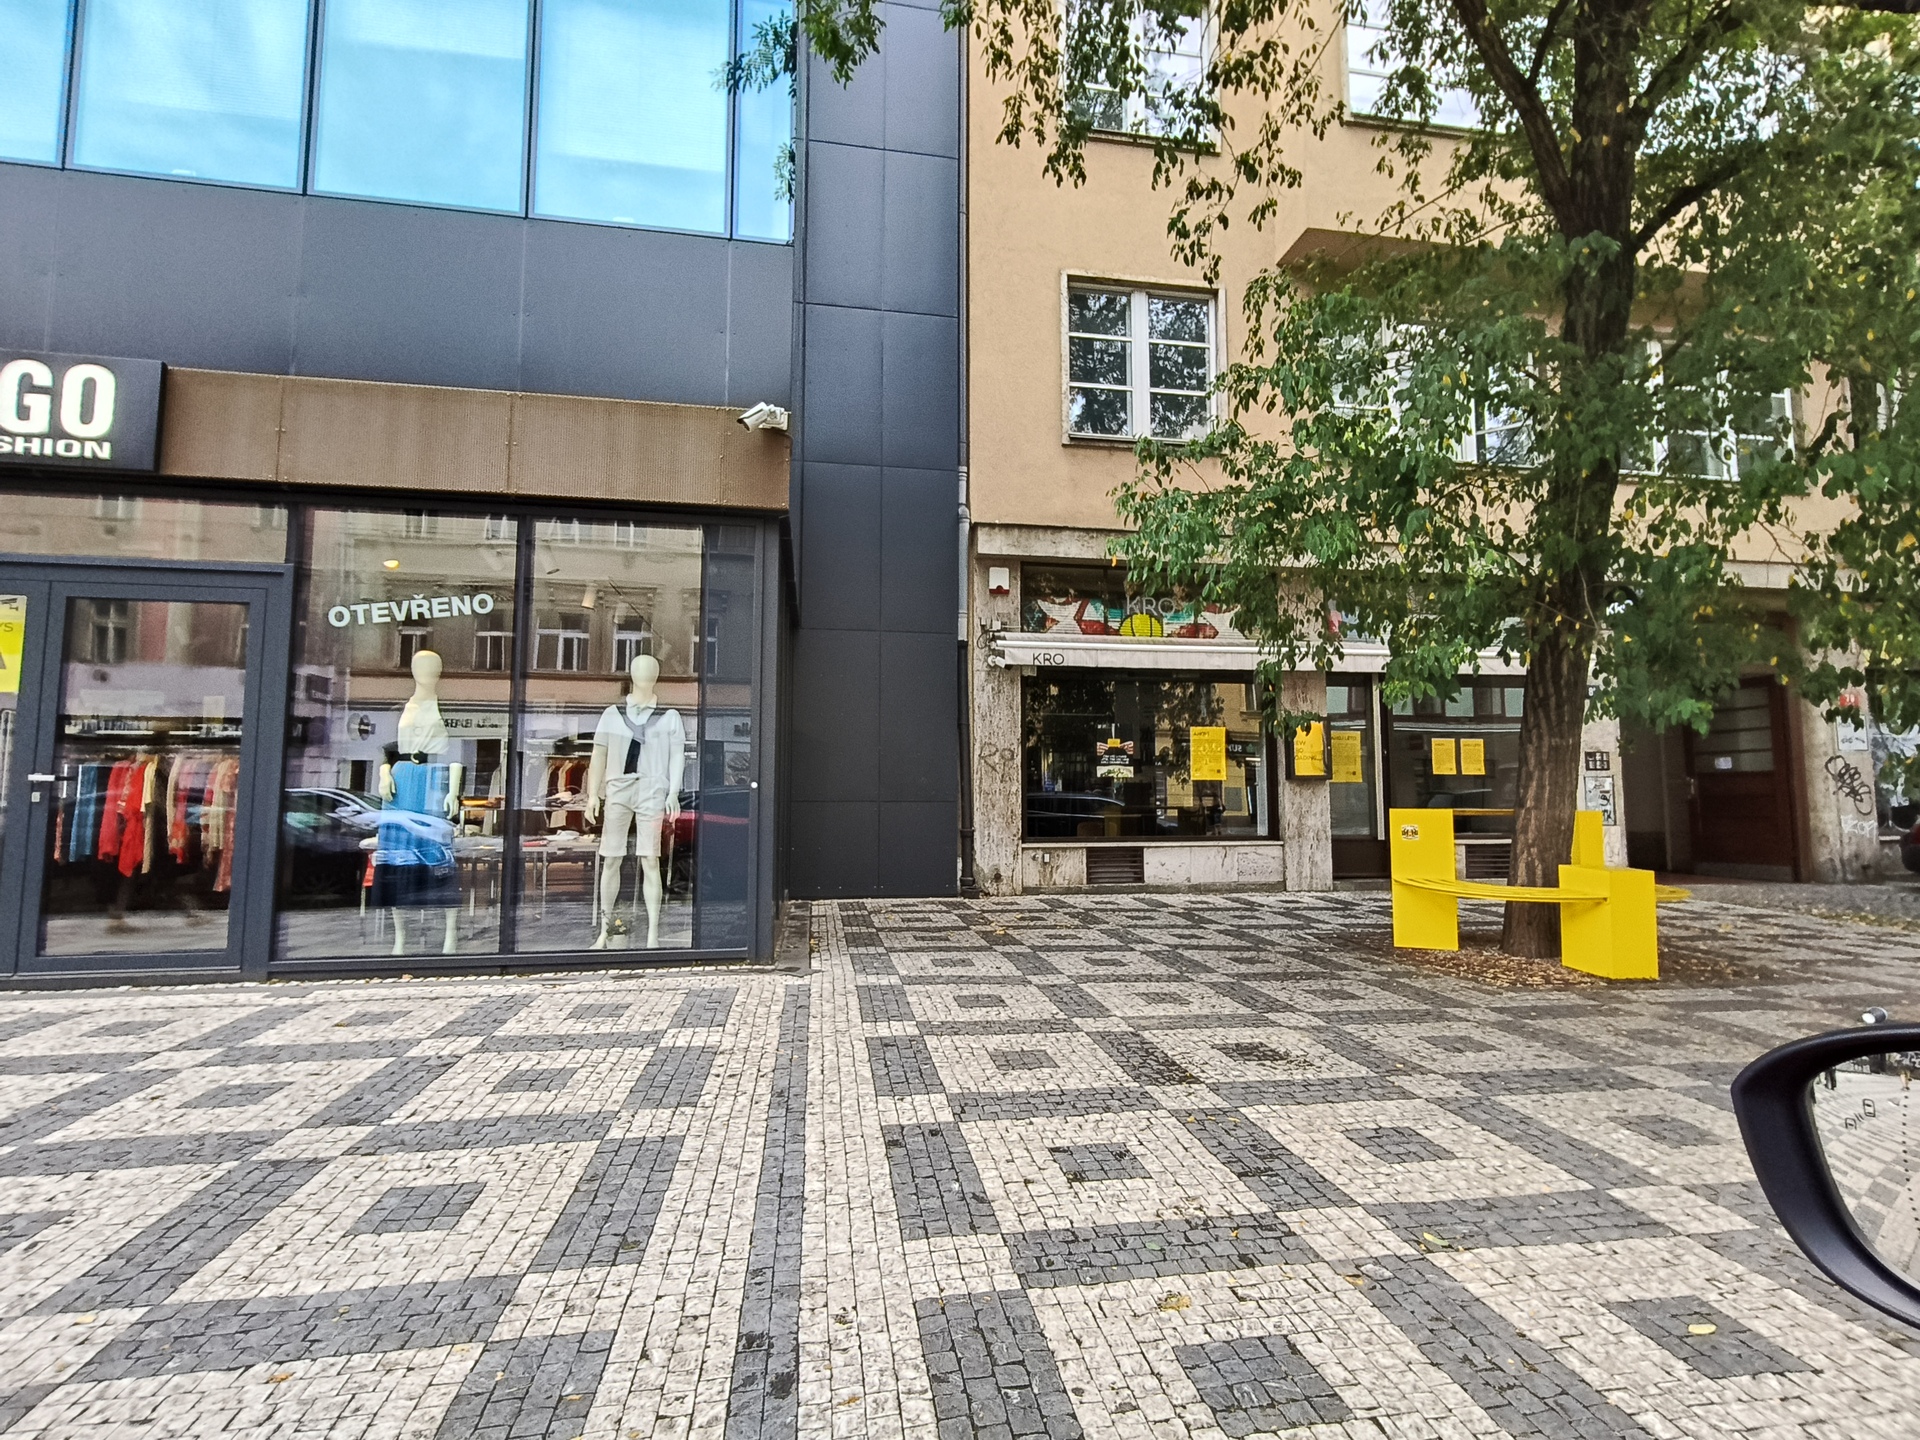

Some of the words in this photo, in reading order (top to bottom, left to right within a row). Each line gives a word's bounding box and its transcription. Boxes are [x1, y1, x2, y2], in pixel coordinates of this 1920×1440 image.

[0, 359, 117, 439] GO
[0, 436, 112, 460] SHION
[328, 593, 494, 628] OTEVŘENO
[1126, 596, 1176, 615] KRO
[1032, 653, 1065, 665] KRO
